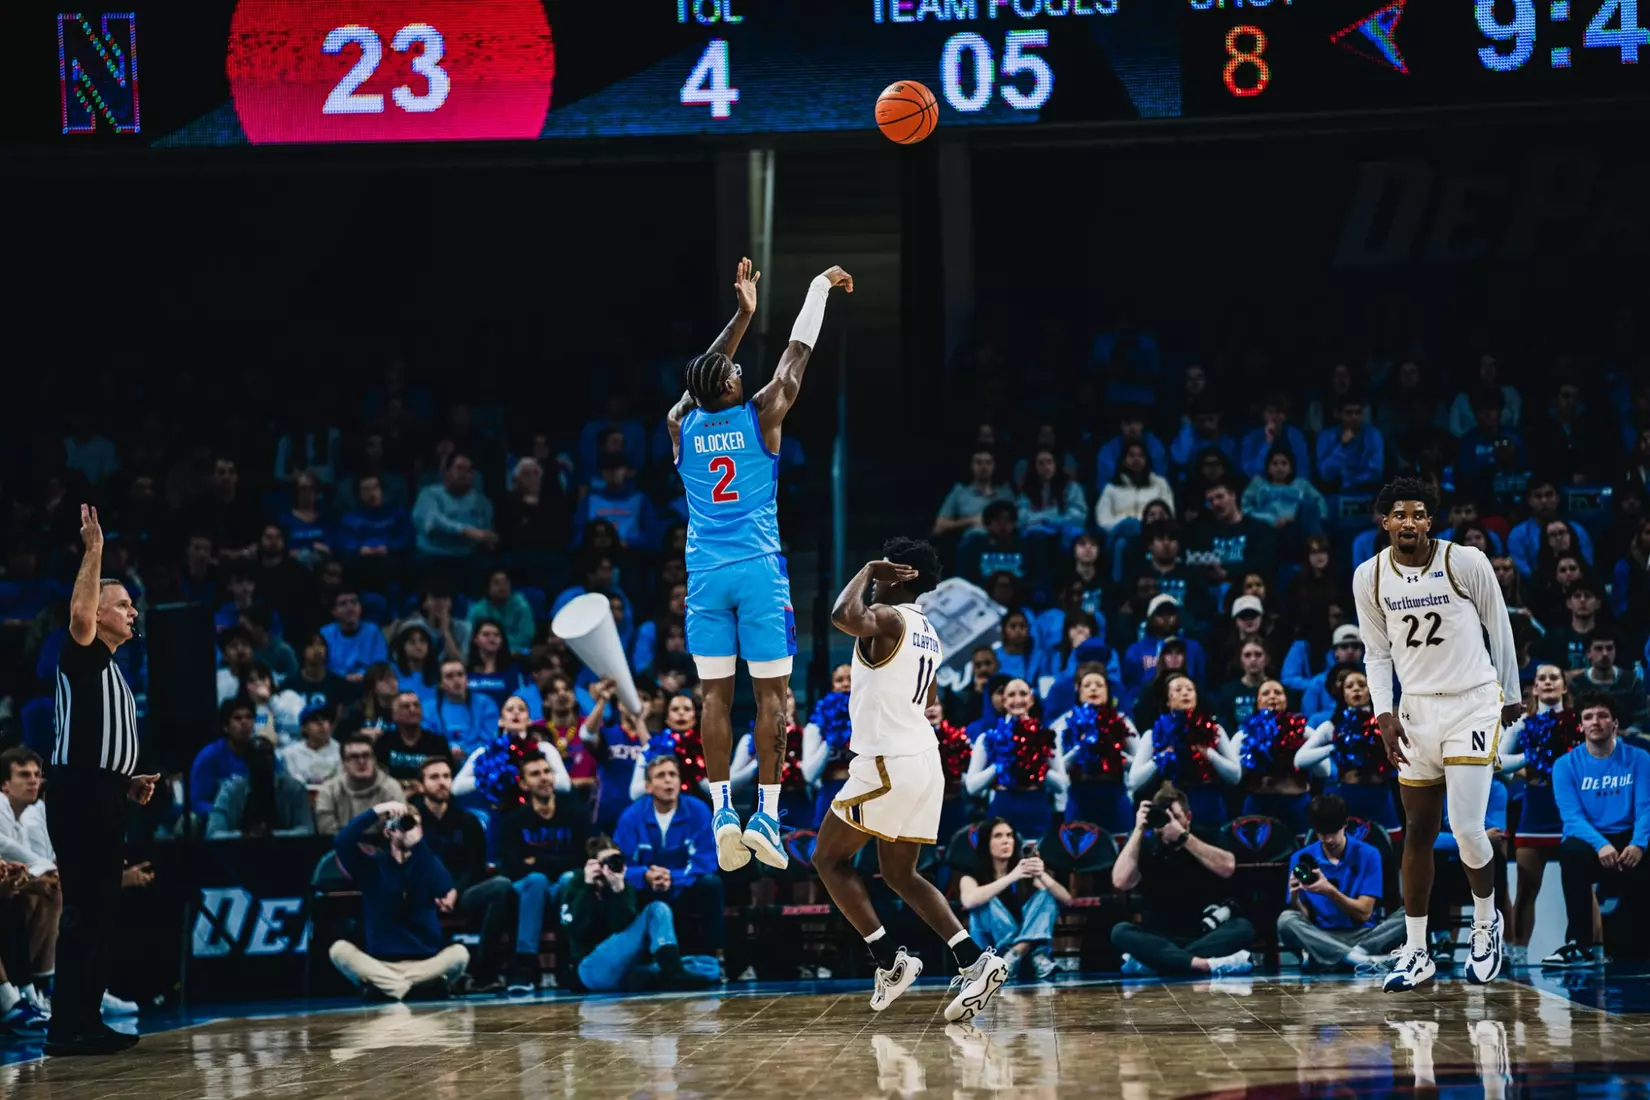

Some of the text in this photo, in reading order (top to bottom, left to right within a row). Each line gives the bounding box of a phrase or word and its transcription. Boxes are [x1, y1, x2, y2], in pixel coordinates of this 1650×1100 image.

[321, 23, 450, 114] 23
[679, 36, 740, 120] 4
[939, 29, 1055, 112] 05
[1223, 24, 1271, 97] 8
[694, 431, 745, 453] BLOCKER
[708, 455, 739, 503] 2
[1384, 593, 1450, 611] Northwestern
[913, 632, 939, 653] CLAYTON
[1401, 611, 1445, 649] 22
[911, 653, 933, 705] 11
[1471, 730, 1486, 752] N
[190, 884, 309, 958] DE
